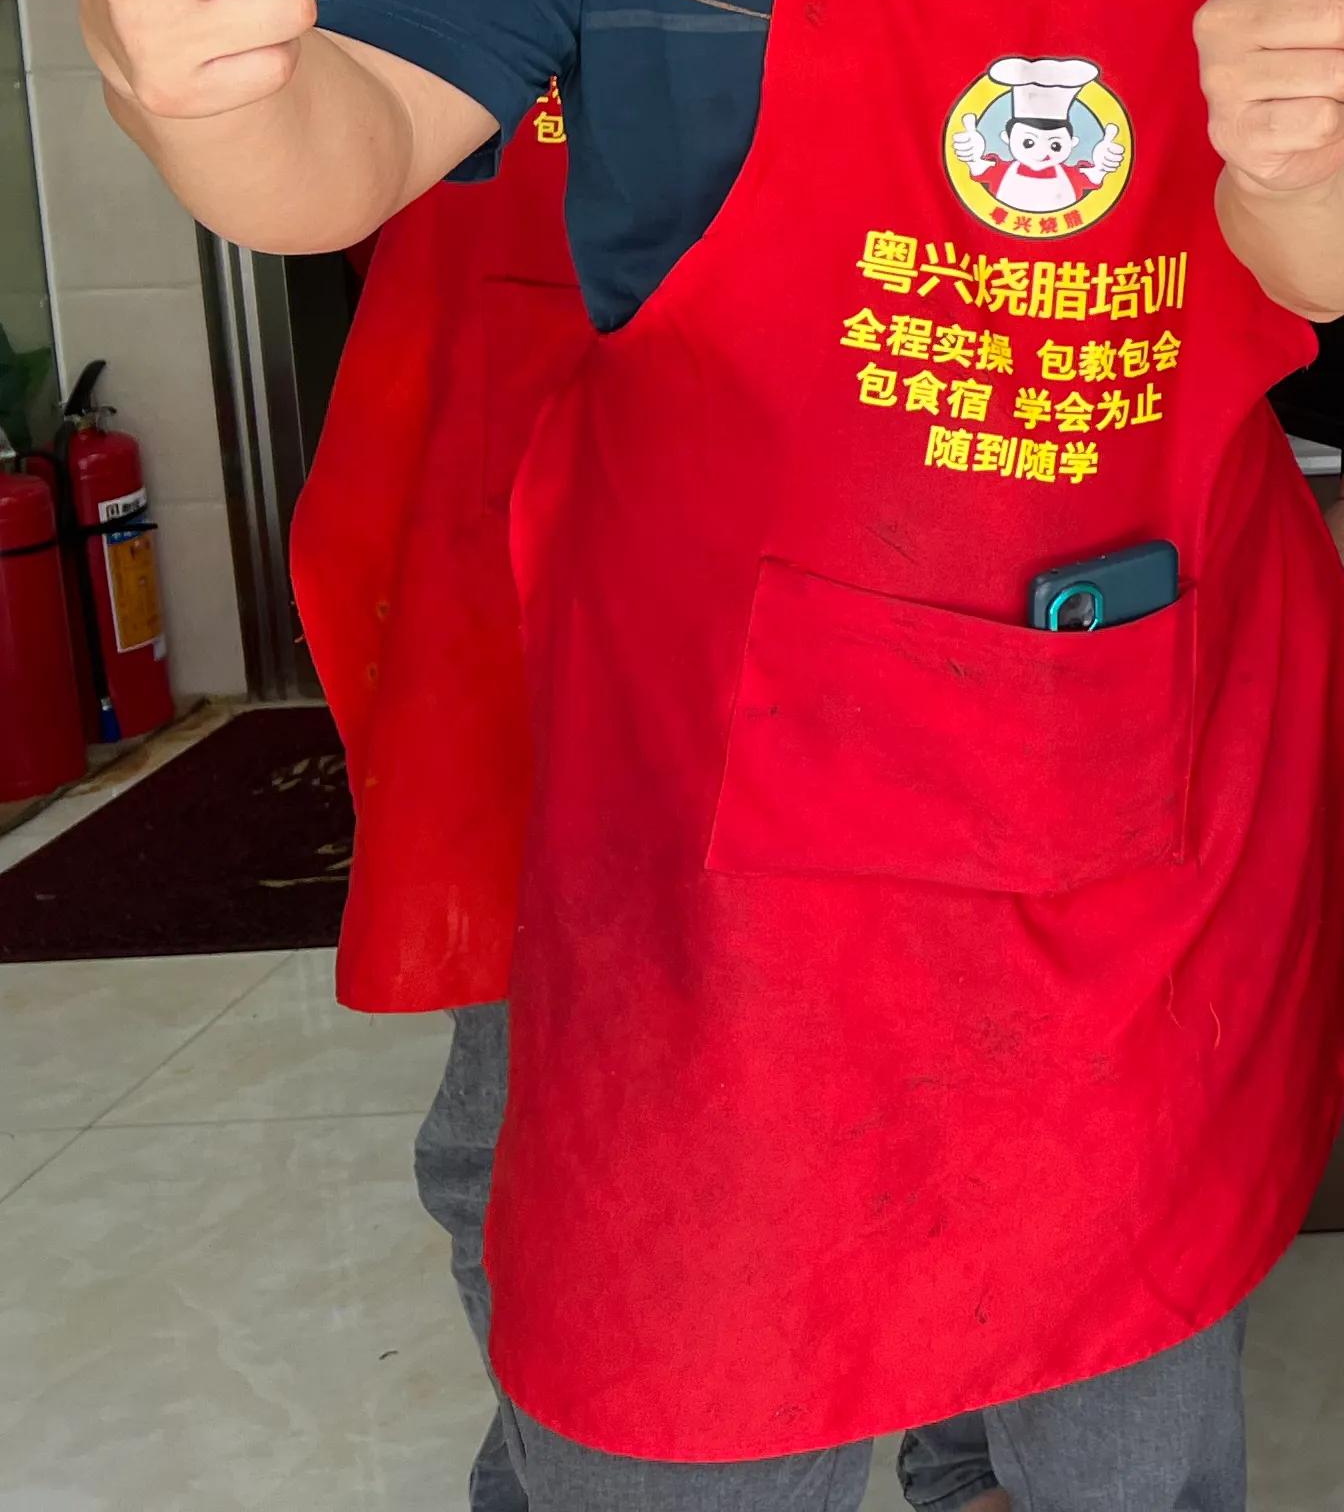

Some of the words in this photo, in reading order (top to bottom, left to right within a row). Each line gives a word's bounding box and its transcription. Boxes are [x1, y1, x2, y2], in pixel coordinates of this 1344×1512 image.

[856, 229, 1188, 321] 粤兴烧腊培训
[839, 307, 1014, 375] 全程实操
[1037, 330, 1182, 382] 包教包会
[856, 361, 993, 422] 包食宿
[1012, 384, 1163, 433] 学会为止
[924, 425, 1099, 485] 随到随学
